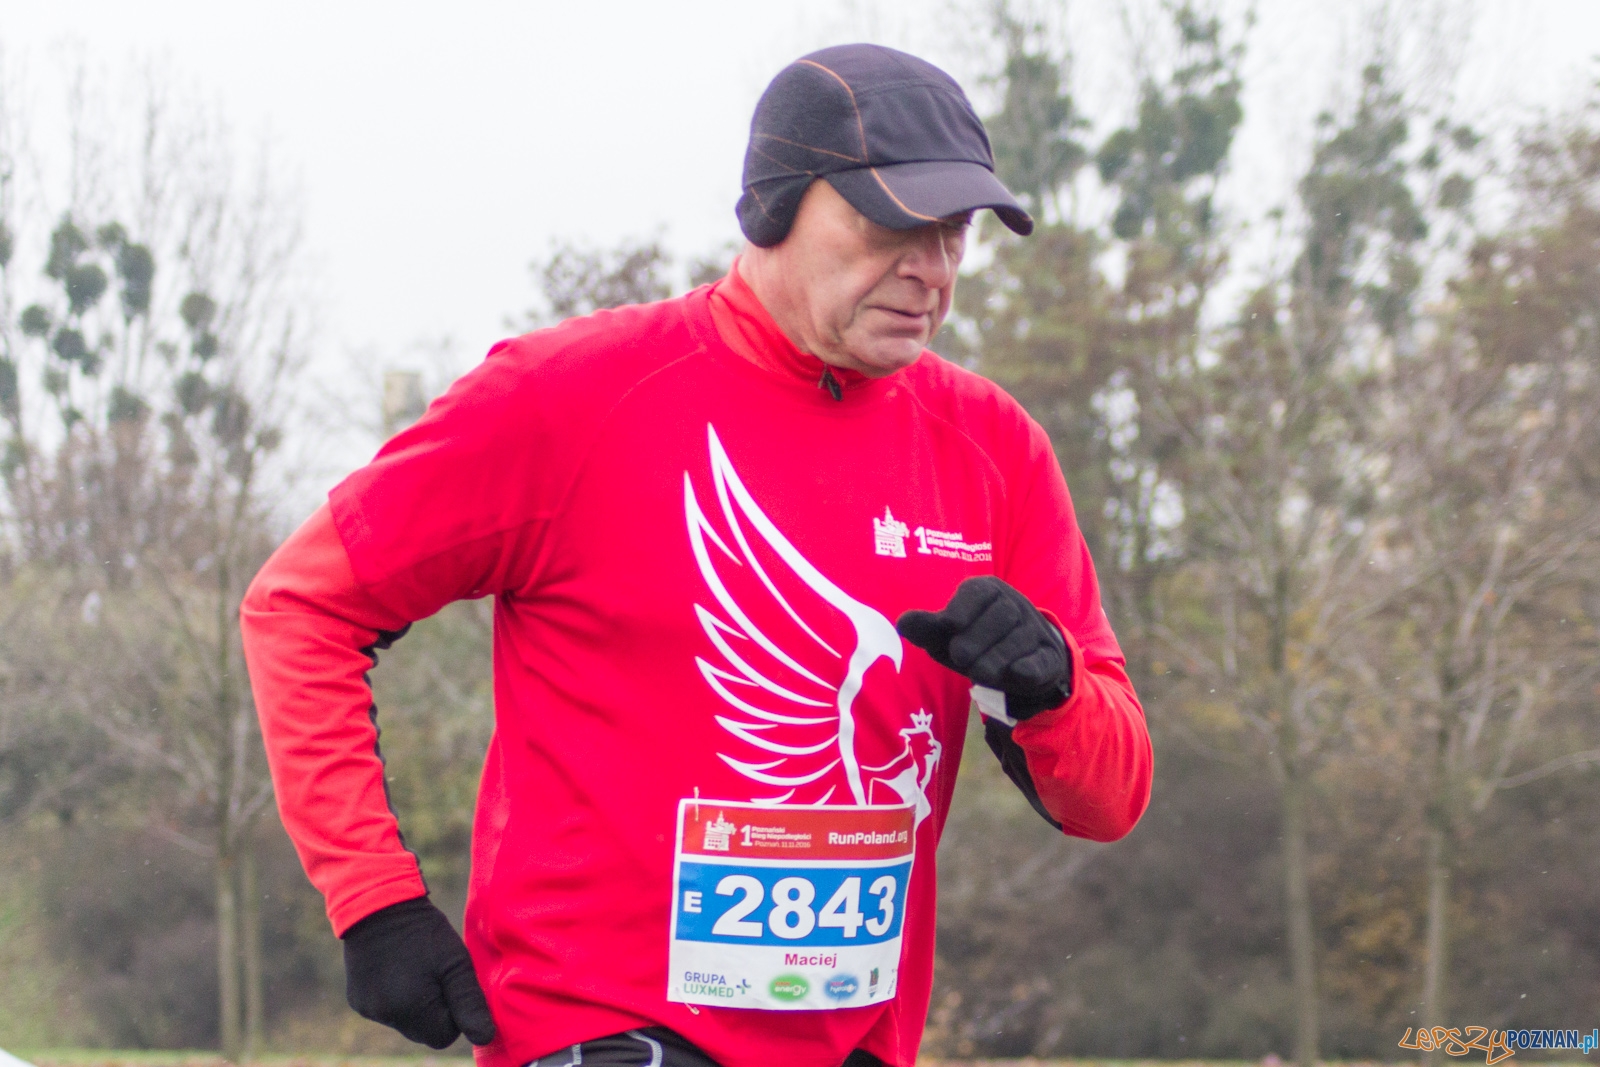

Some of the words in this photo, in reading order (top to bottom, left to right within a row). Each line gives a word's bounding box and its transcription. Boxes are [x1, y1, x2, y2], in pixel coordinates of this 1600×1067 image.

[914, 526, 932, 554] 1
[740, 824, 753, 846] 1
[828, 830, 908, 844] RunPoland.org
[683, 890, 702, 913] E
[712, 874, 897, 940] 2843
[784, 953, 838, 969] Maciej
[684, 971, 727, 986] GRUPA
[683, 983, 735, 998] LUXMED
[774, 985, 807, 996] energy
